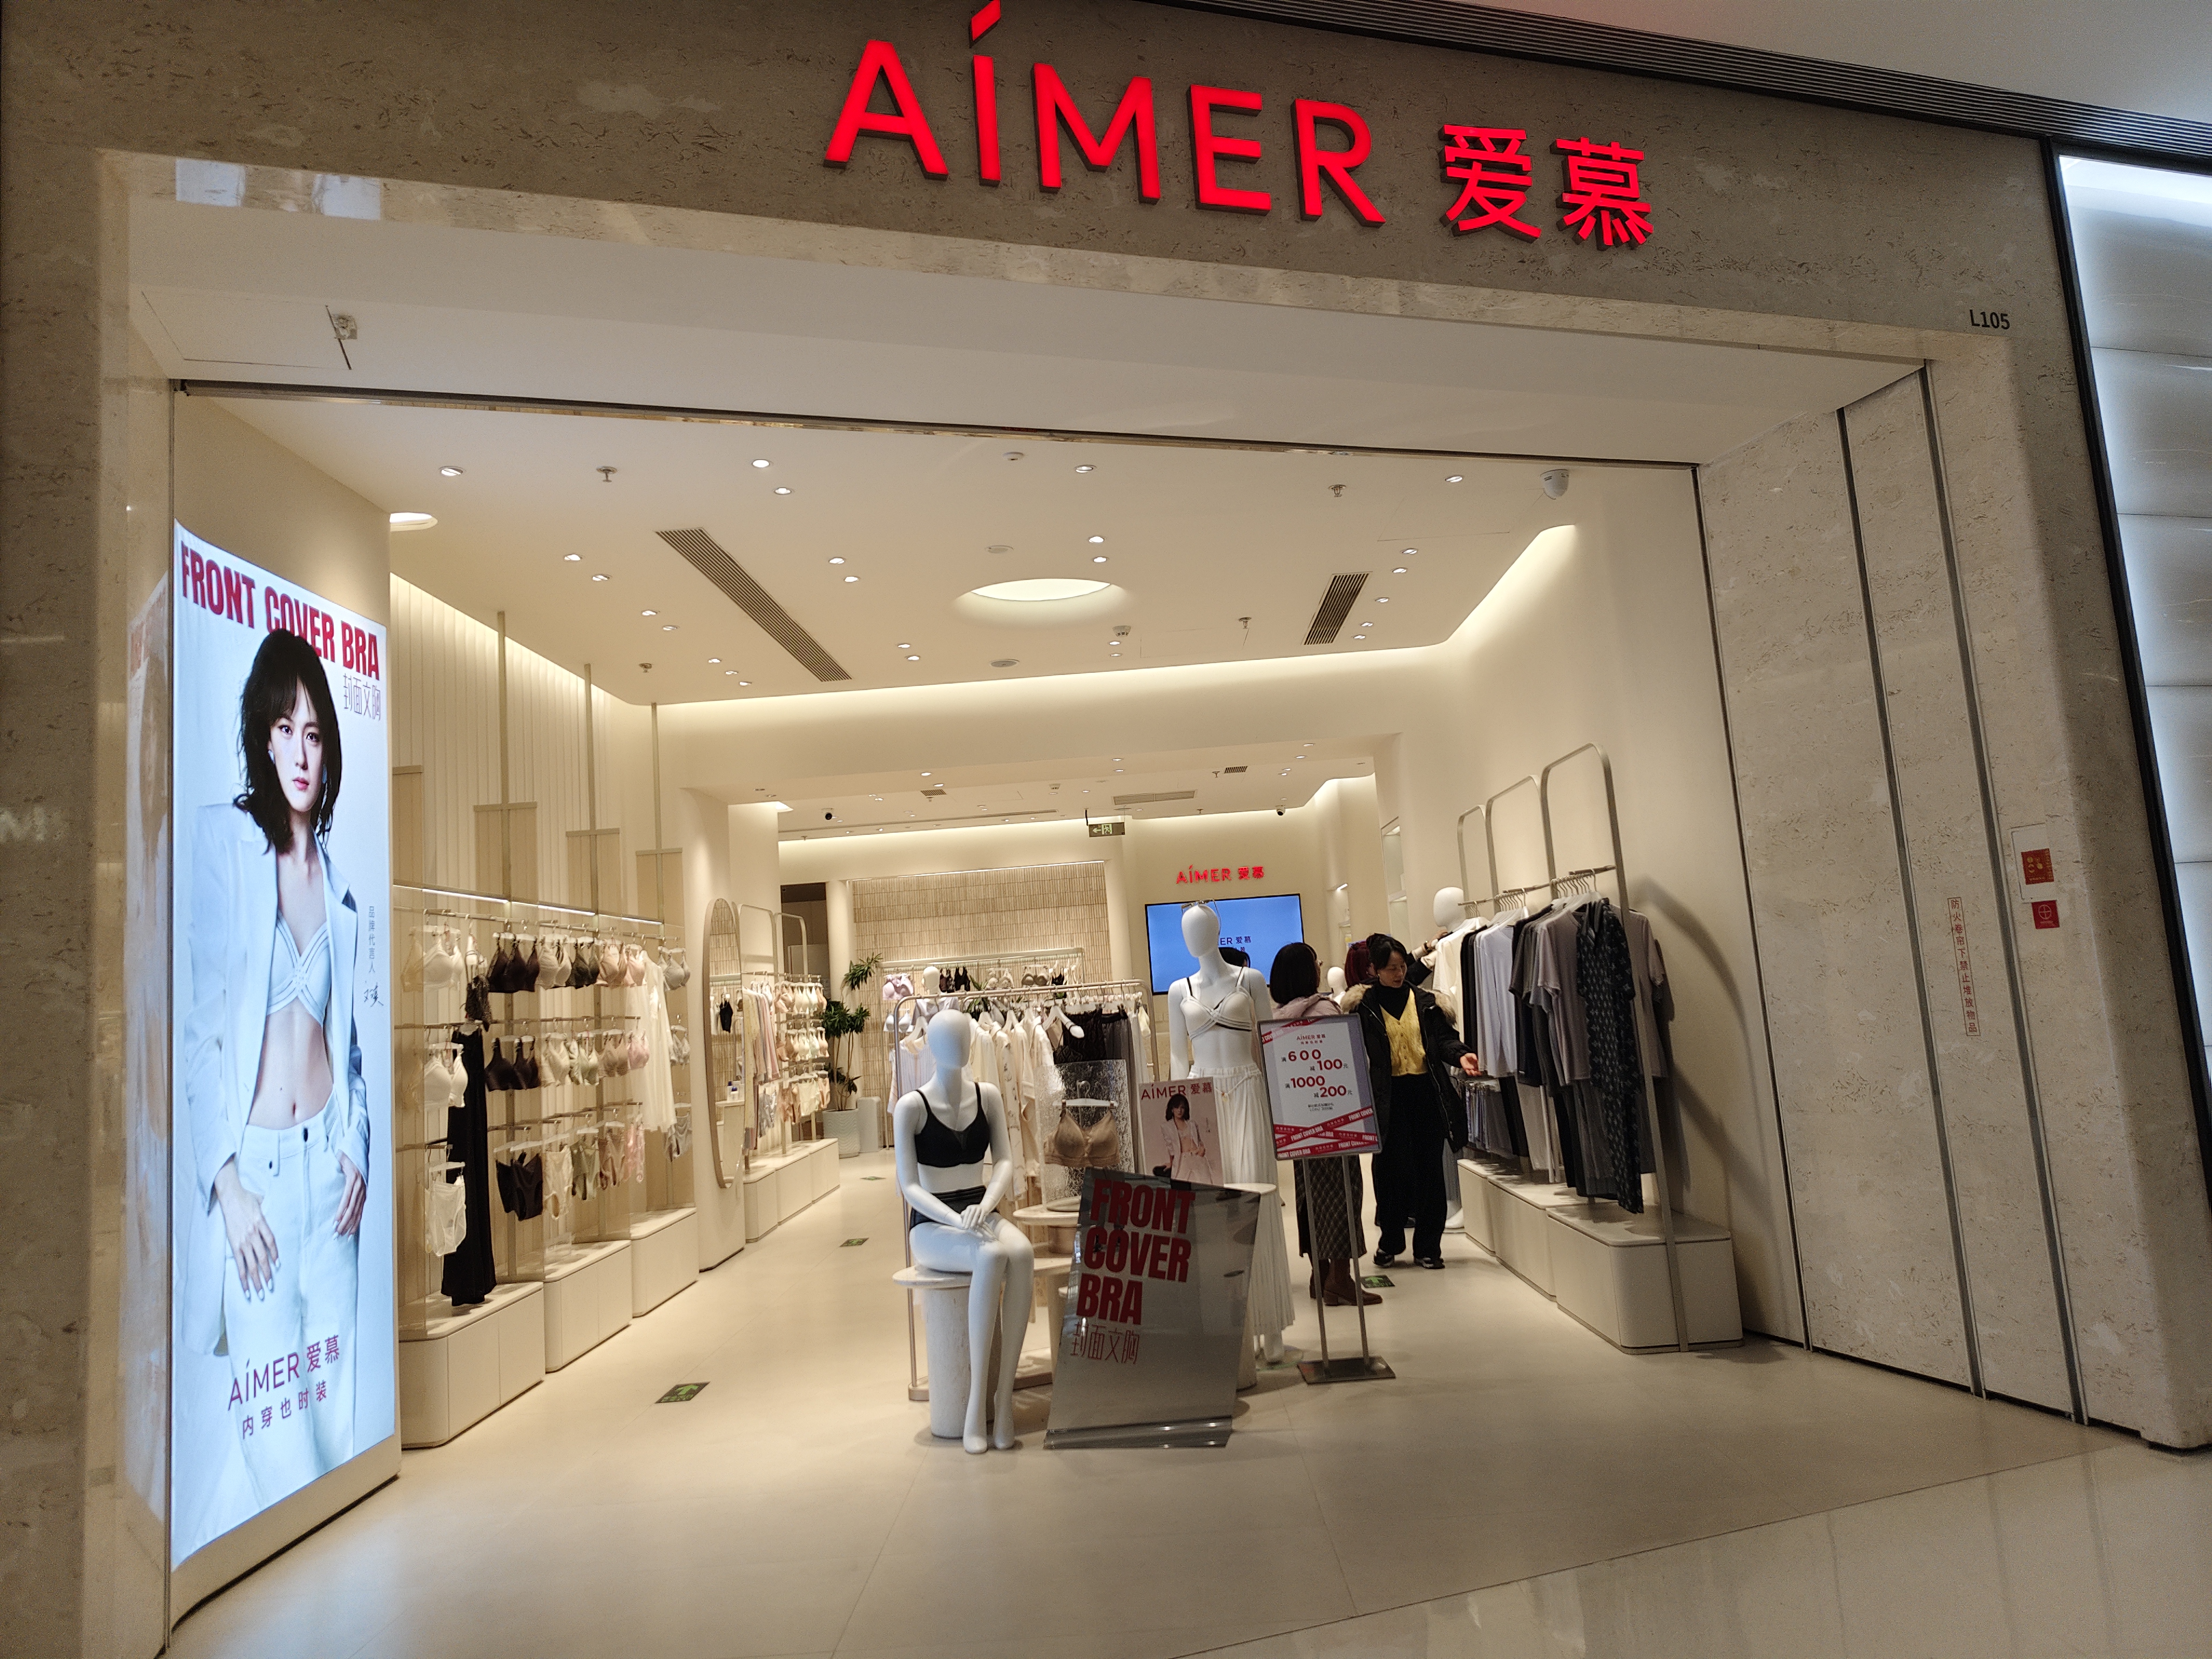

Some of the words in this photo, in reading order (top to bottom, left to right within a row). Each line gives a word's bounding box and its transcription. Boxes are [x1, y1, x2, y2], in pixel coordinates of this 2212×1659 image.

[1439, 123, 1655, 251] 爱慕
[1970, 309, 2010, 329] L105
[181, 540, 255, 629] FRONT
[265, 586, 336, 663] COVER
[341, 621, 380, 681] BRA
[343, 673, 381, 721] 封面文胸
[1238, 866, 1264, 880] 爱慕
[1951, 899, 1977, 1033] 防火卷帘下禁止堆放物品
[1191, 1082, 1212, 1095] 爱慕
[1090, 1177, 1196, 1235] FRONT
[1083, 1226, 1191, 1283] COVER
[1076, 1273, 1143, 1325] BRA
[306, 1334, 340, 1373] 爱慕
[1070, 1321, 1140, 1365] 封面文胸
[242, 1379, 327, 1440] 内穿也时装
